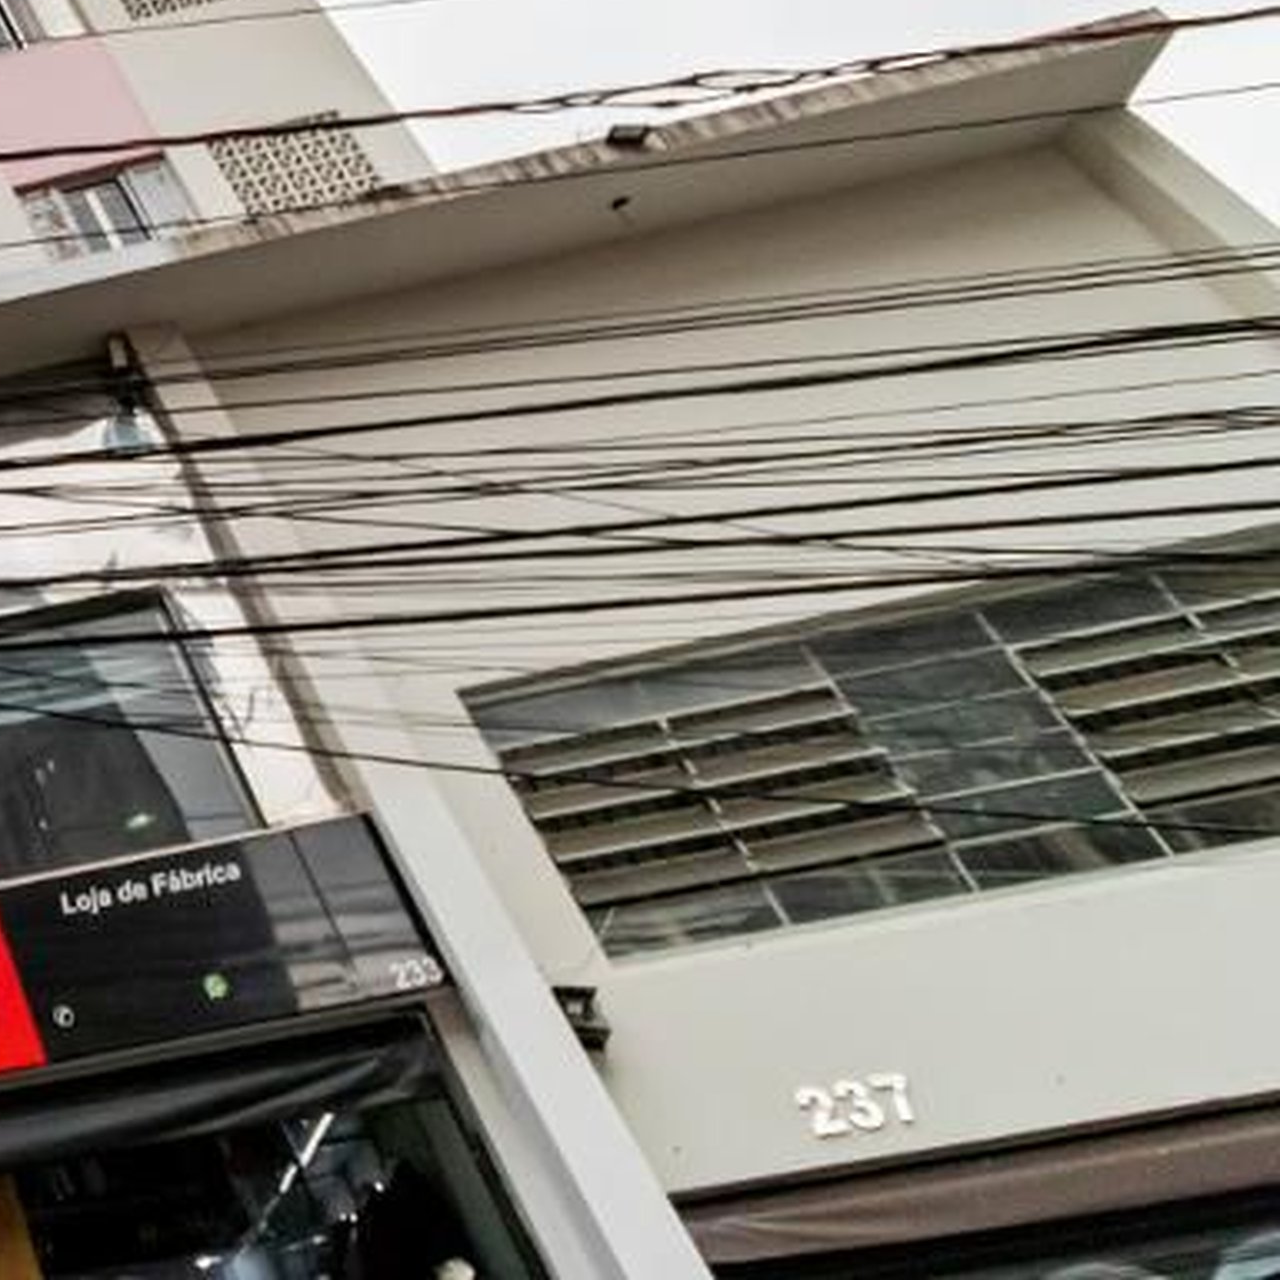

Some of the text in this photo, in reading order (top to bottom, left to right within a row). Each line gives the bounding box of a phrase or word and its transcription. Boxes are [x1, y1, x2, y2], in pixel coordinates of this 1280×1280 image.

[60, 859, 241, 915] Loja de Fábrica
[389, 955, 443, 990] 233
[795, 1072, 914, 1141] 237
